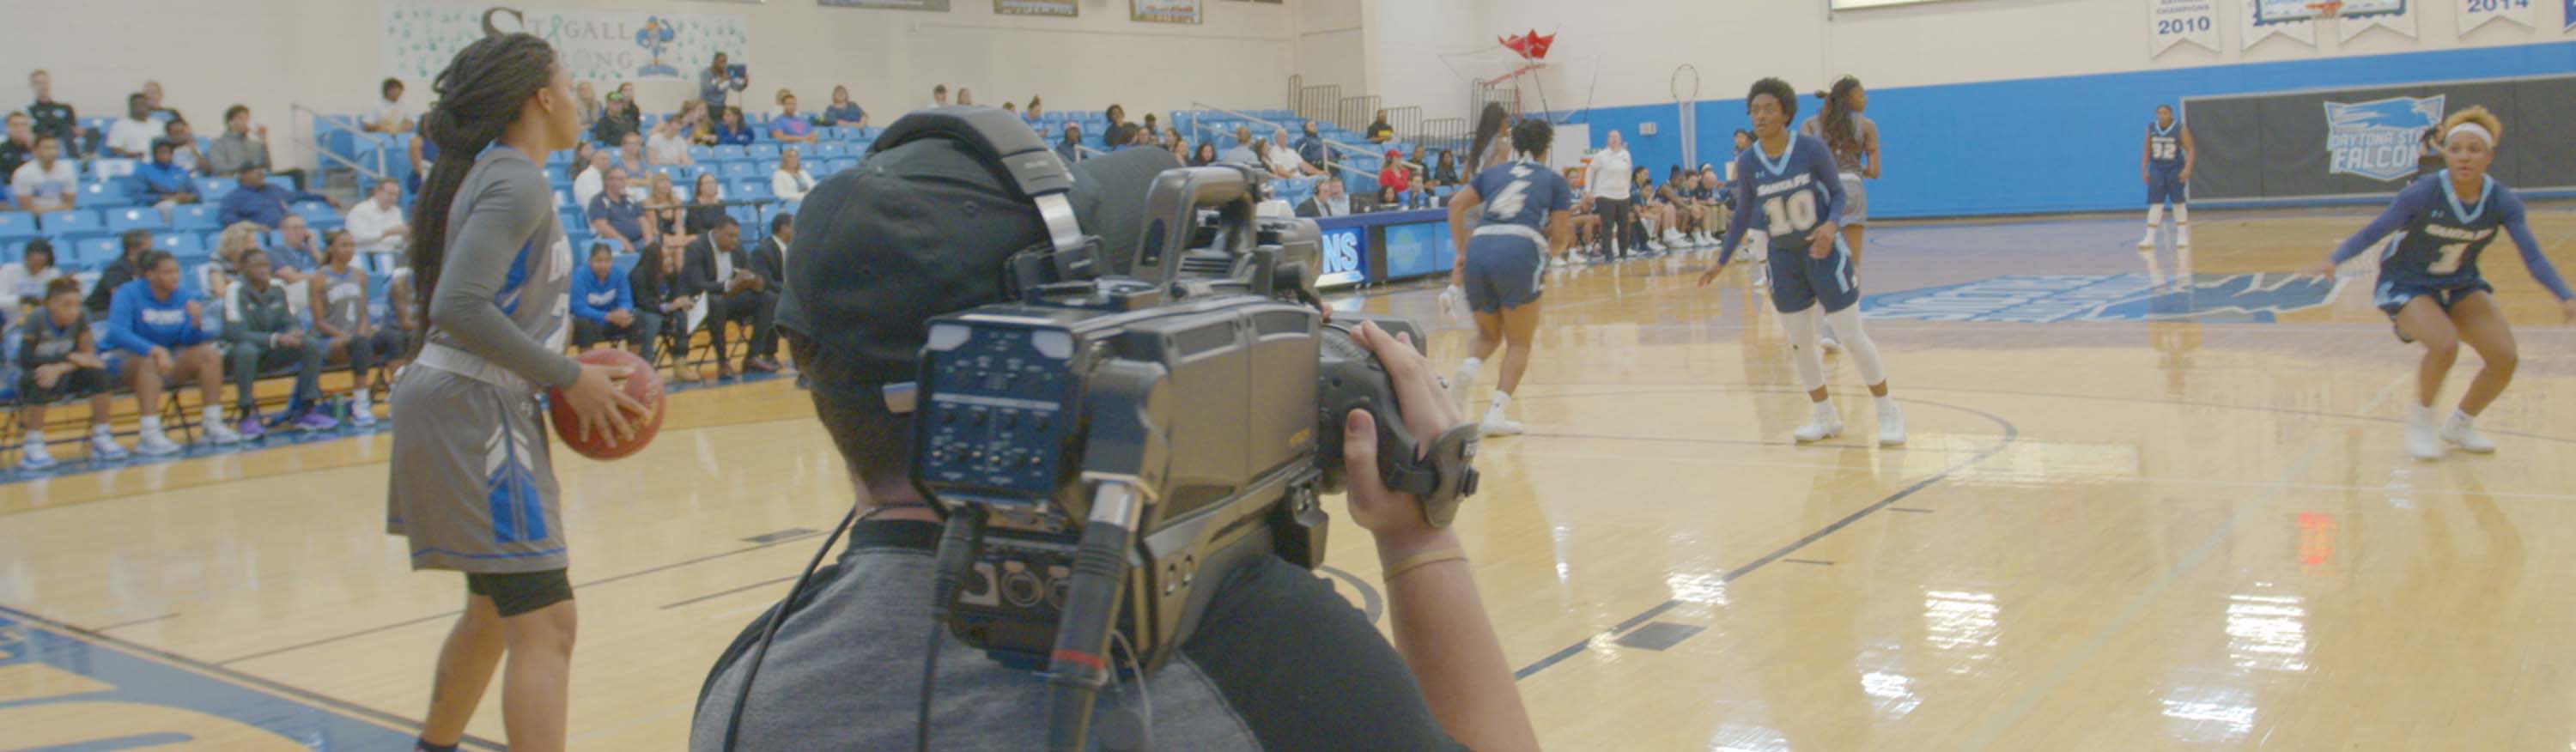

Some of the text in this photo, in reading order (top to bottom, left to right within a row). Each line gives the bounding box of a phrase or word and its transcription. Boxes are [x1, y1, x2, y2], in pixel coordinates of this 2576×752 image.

[2158, 16, 2211, 34] 2010
[2333, 131, 2393, 147] DAYTONA
[1763, 188, 1817, 237] 10
